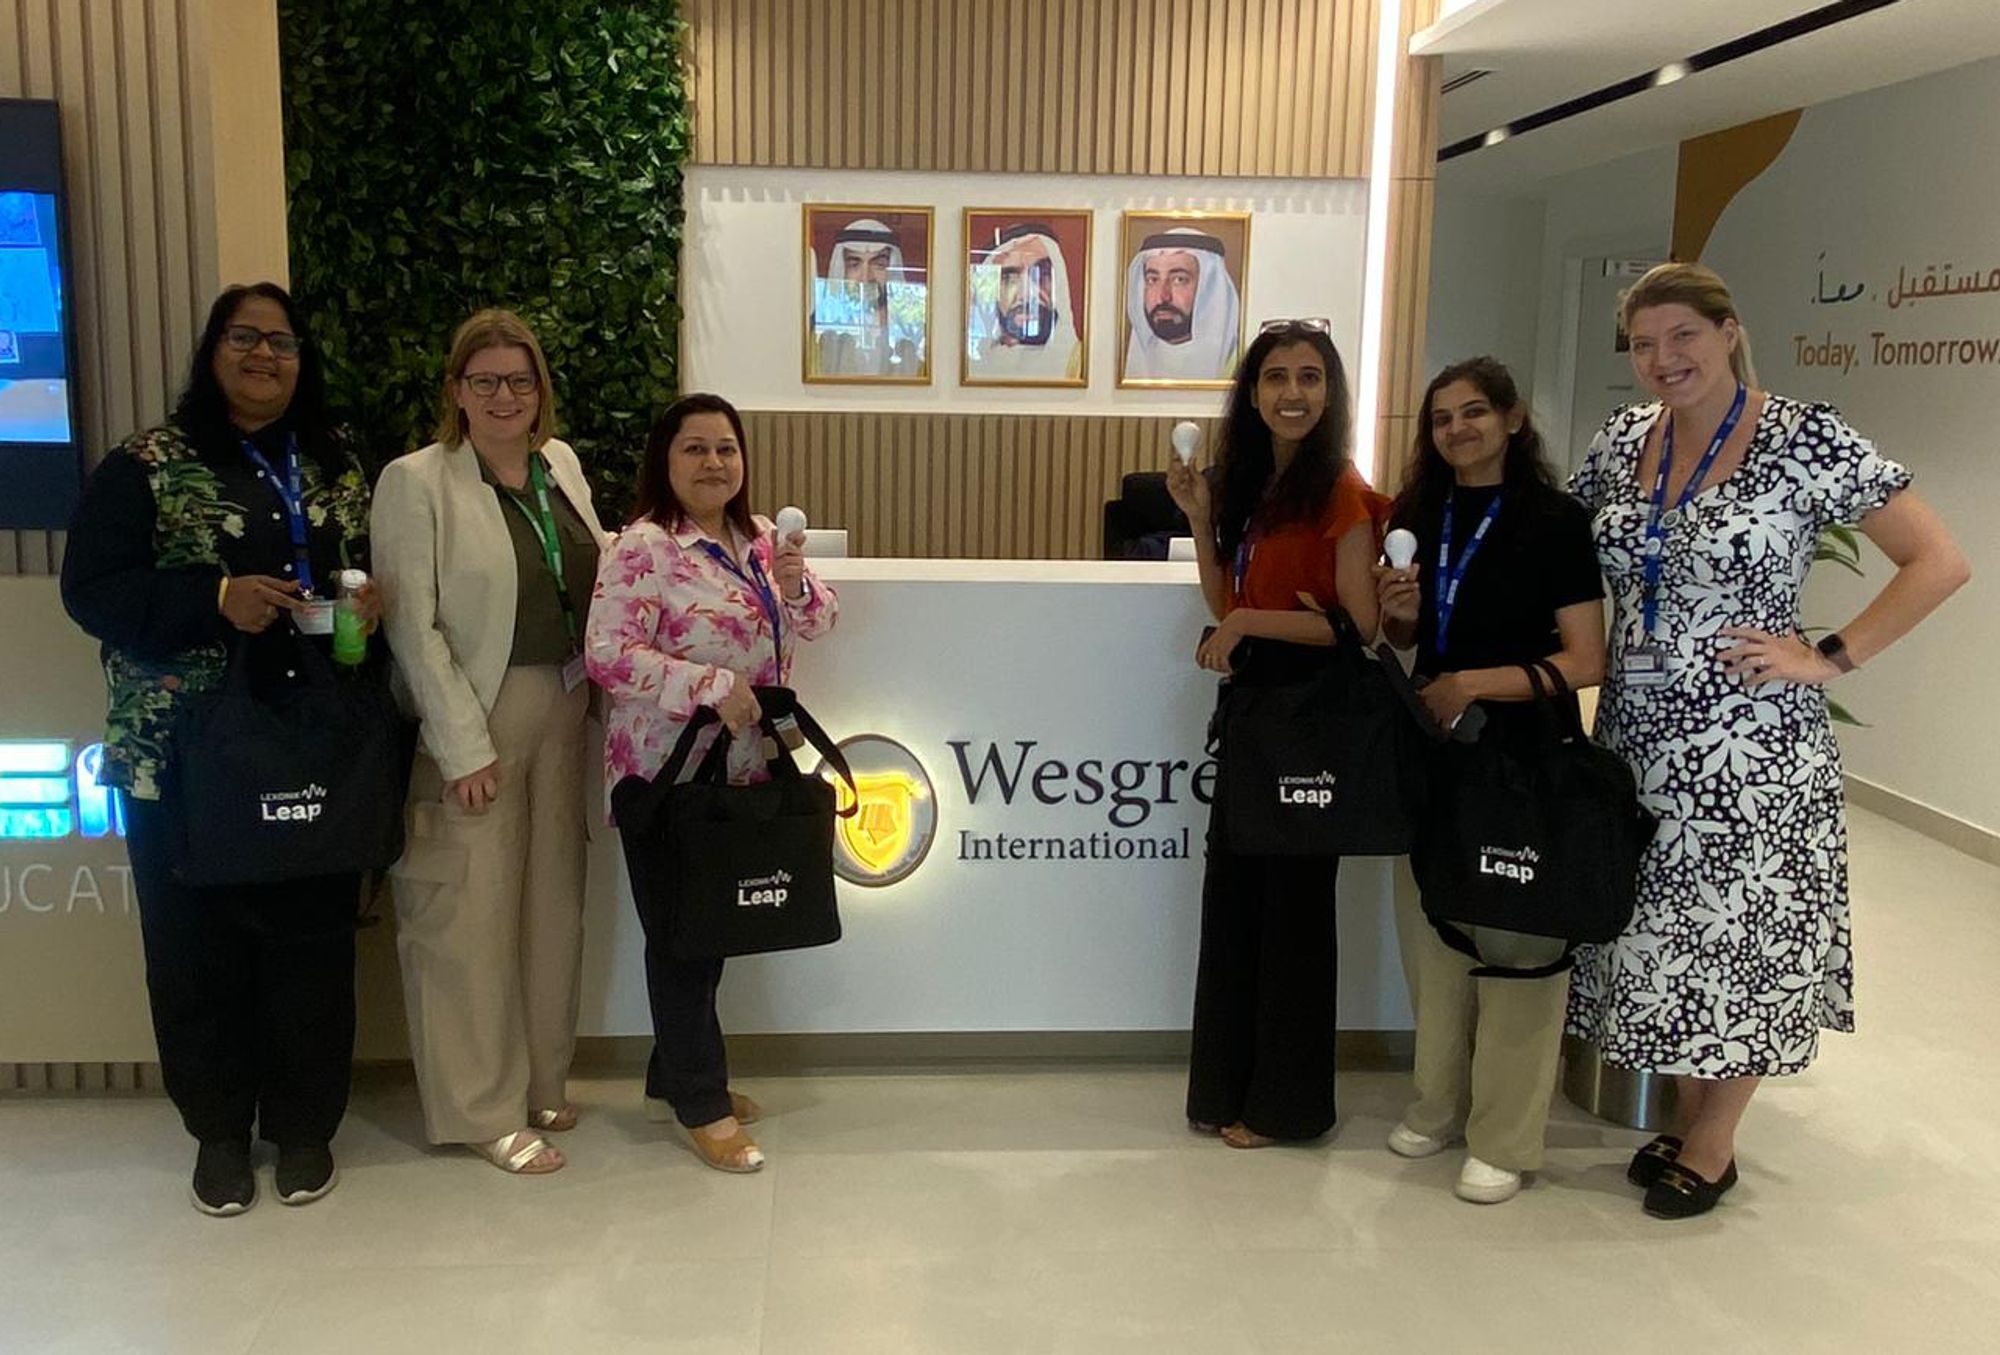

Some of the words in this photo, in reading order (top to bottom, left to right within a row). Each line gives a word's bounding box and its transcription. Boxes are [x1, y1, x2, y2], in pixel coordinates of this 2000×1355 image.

[1794, 331, 1859, 375] Today.
[1280, 786, 1332, 808] Leap
[262, 803, 322, 822] Leap
[957, 827, 1190, 860] International
[1480, 855, 1534, 884] Leap
[738, 889, 788, 907] Leap
